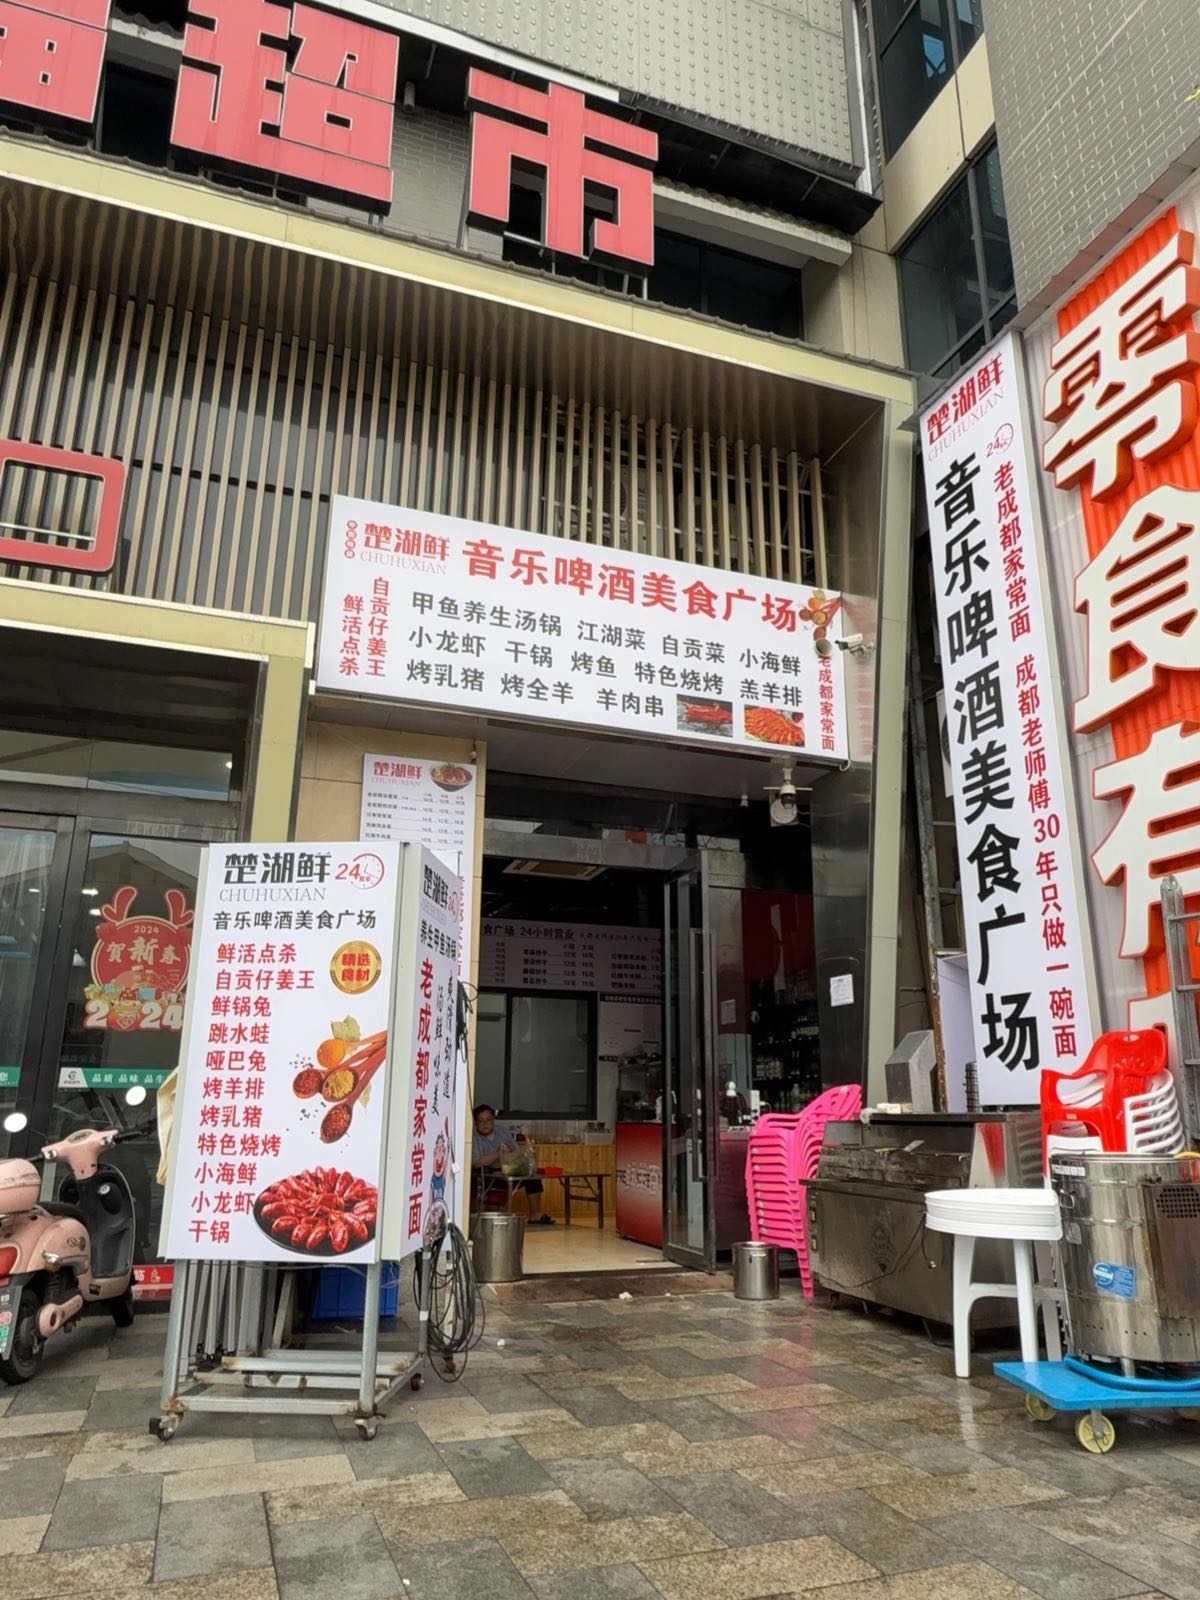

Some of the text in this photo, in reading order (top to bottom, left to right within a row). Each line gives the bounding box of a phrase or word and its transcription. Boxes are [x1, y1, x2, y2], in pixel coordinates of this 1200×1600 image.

[928, 390, 1004, 461] CHUHUXIAN
[360, 550, 447, 575] CHUHUXIAN
[462, 539, 797, 633] 音乐啤酒美食广场
[339, 594, 364, 676] 鲜活点杀
[366, 576, 390, 677] 自贡仔姜王
[412, 591, 801, 677] 甲鱼养生汤锅 江湖菜 自贡菜 小海鲜
[409, 625, 486, 658] 小龙虾
[505, 640, 553, 669] 干锅
[571, 650, 617, 679] 烤鱼
[634, 660, 724, 696] 特色烧烤
[406, 658, 664, 718] 烤乳猪 烤全羊 羊肉串
[934, 452, 1040, 1072] 音乐啤酒美食广场
[993, 460, 1077, 1058] 老成都家常面 成都老师傅30年只做一碗面
[335, 863, 360, 880] 24
[219, 887, 326, 902] CHUHUXIAN
[134, 925, 160, 933] 2024
[213, 909, 377, 931] 音乐啤酒美食广场
[216, 943, 297, 964] 鲜活点杀
[215, 969, 316, 990] 自贡仔姜王
[211, 995, 272, 1017] 鲜锅兔
[208, 1022, 270, 1044] 跳水蛙
[206, 1049, 267, 1072] 哑巴兔
[202, 1077, 265, 1100] 烤羊排
[408, 957, 434, 1240] 老成都家常面
[200, 1105, 263, 1128] 烤乳猪
[197, 1133, 281, 1157] 特色烧烤
[194, 1162, 257, 1186] 小海鲜
[191, 1190, 256, 1215] 小龙虾
[188, 1220, 230, 1244] 干锅
